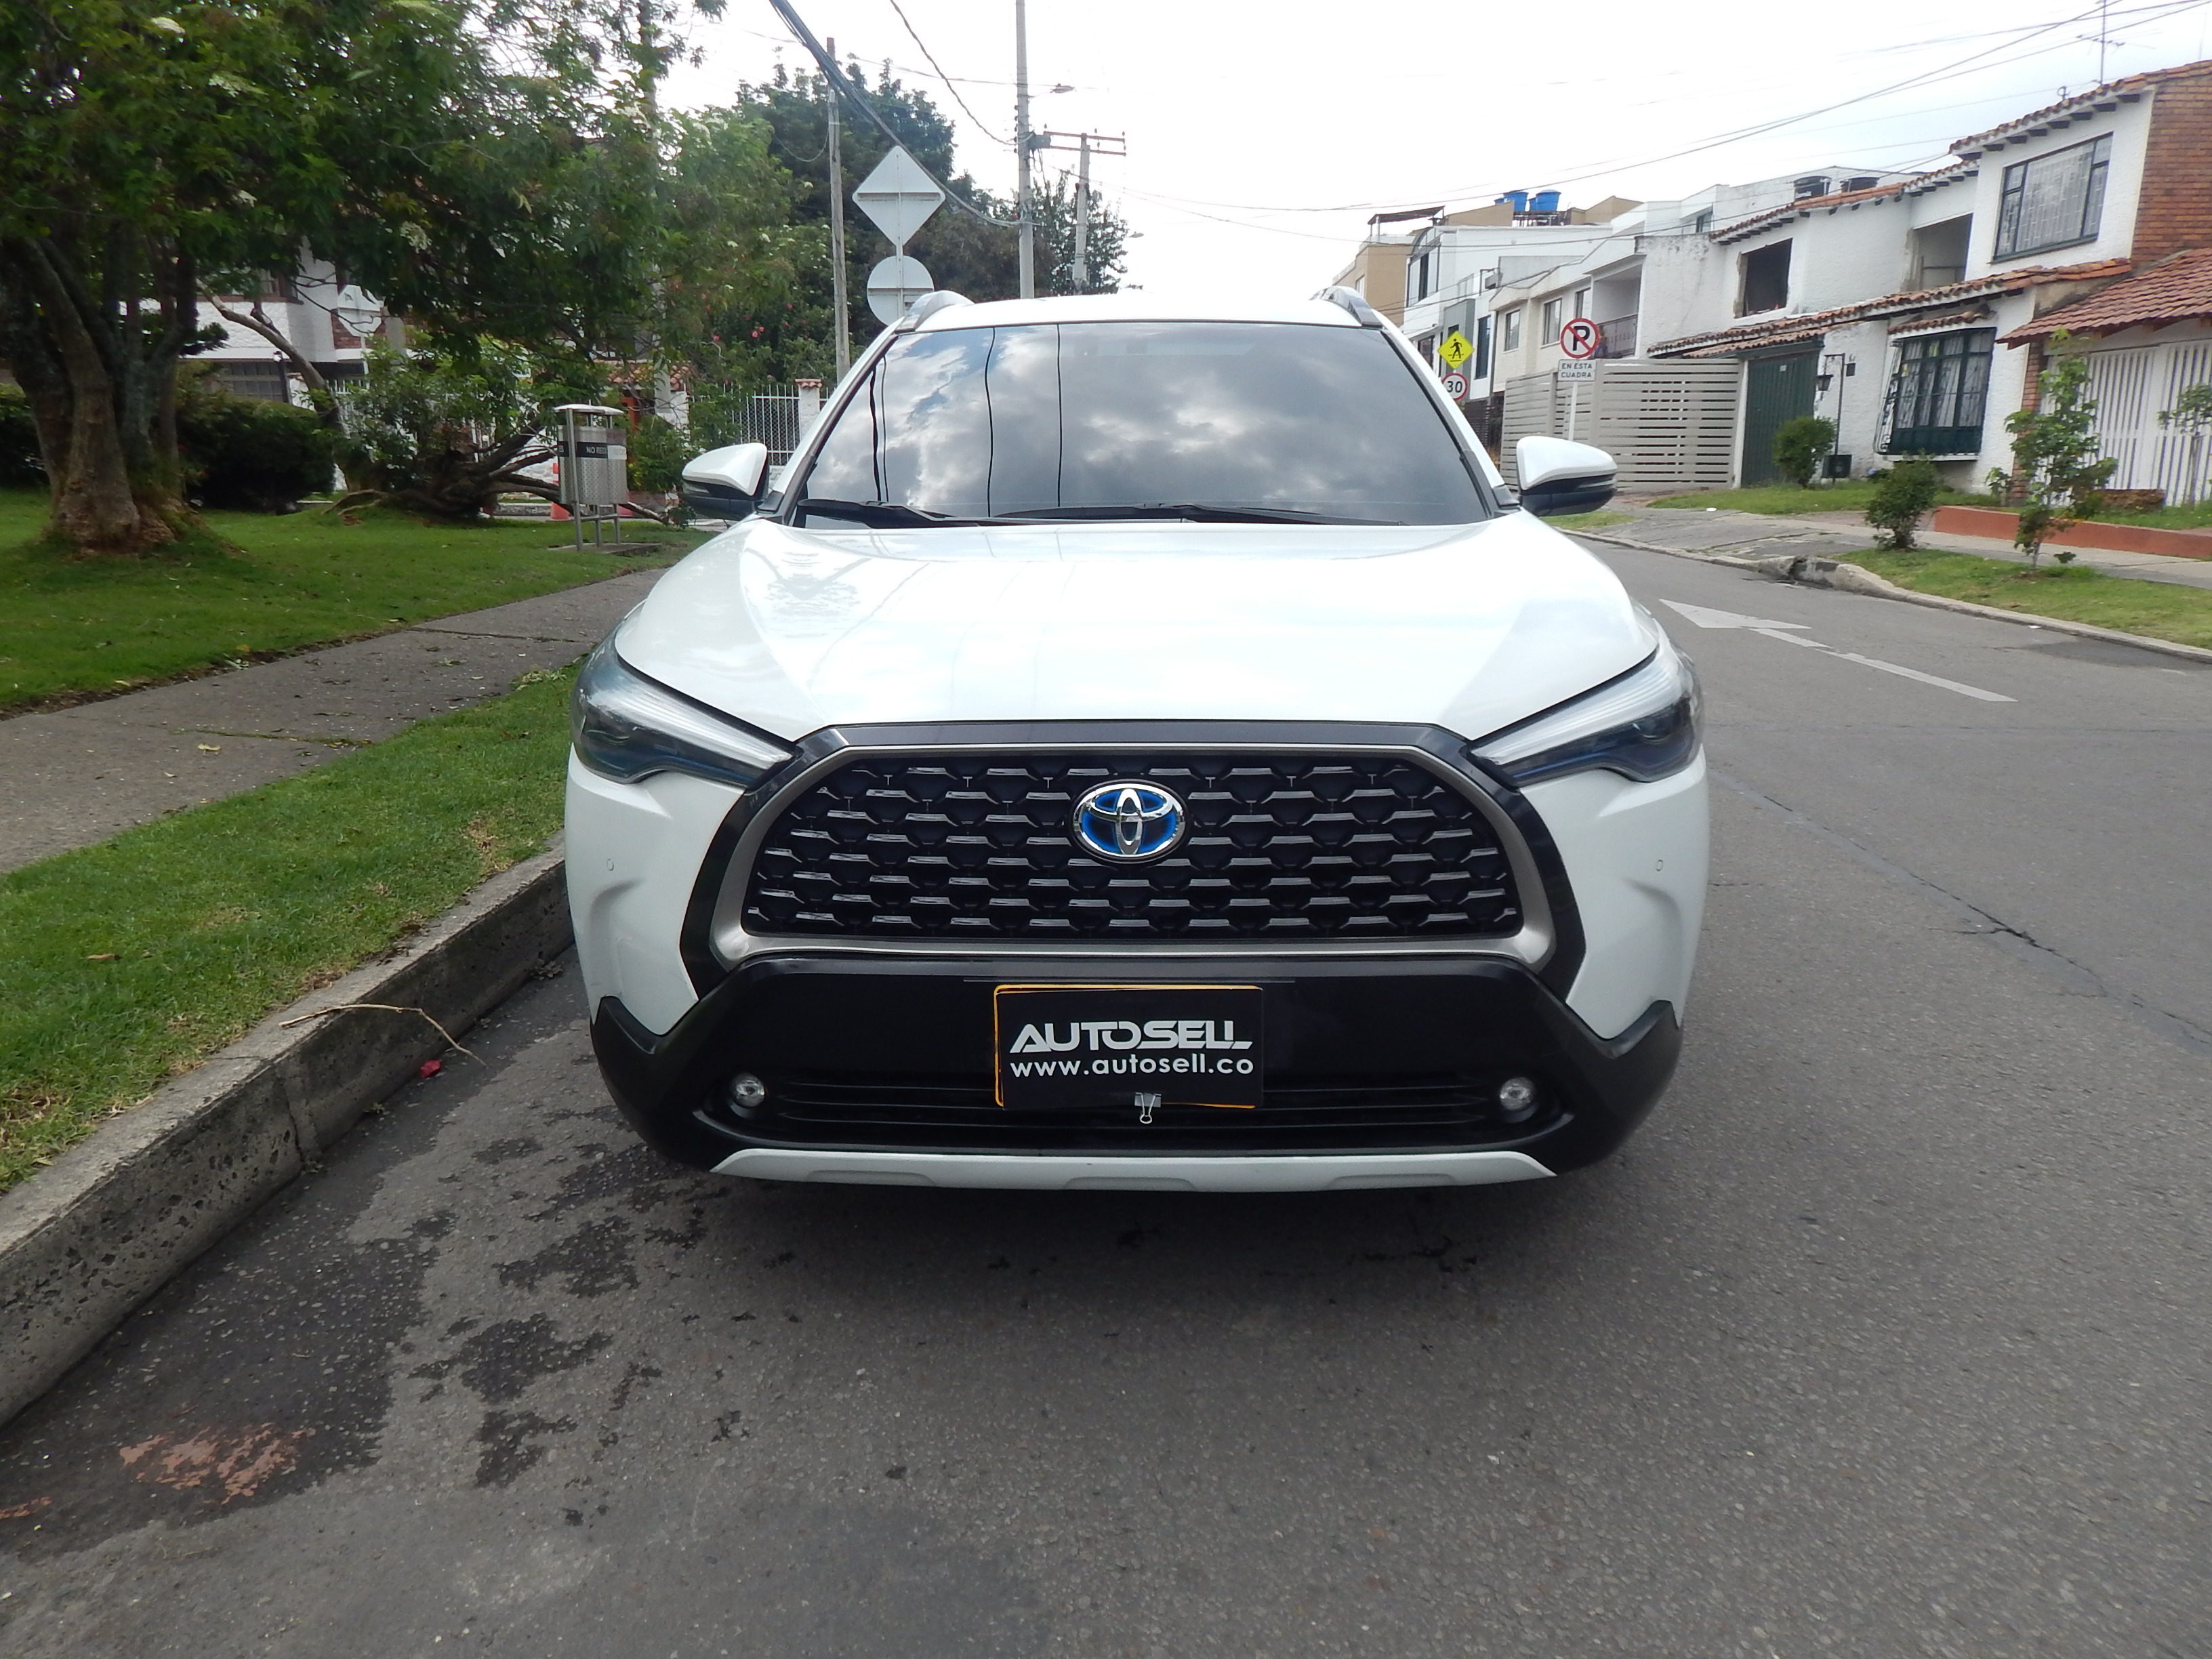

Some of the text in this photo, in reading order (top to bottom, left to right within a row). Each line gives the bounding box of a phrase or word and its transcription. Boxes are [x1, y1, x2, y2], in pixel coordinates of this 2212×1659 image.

[1572, 325, 1591, 351] P
[1447, 380, 1462, 393] 30
[1010, 1020, 1253, 1053] AUTOSELL
[1010, 1053, 1254, 1078] www.autosell.co
